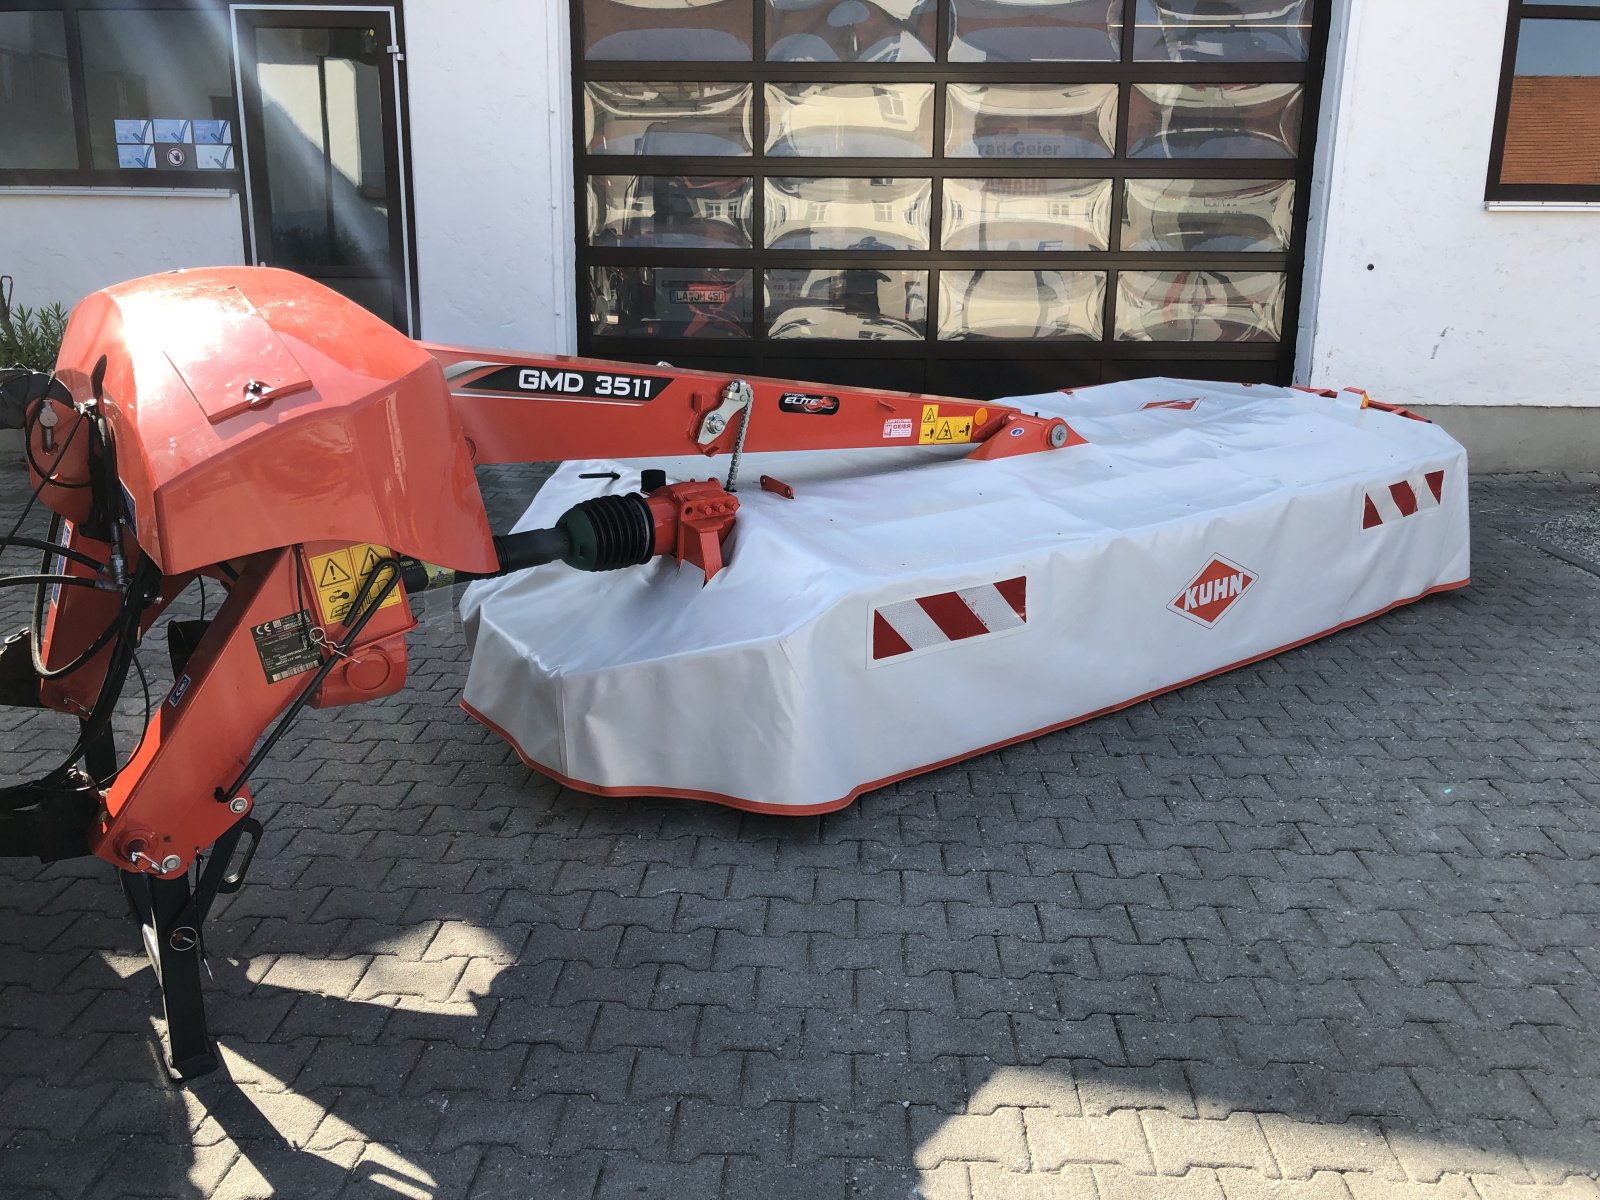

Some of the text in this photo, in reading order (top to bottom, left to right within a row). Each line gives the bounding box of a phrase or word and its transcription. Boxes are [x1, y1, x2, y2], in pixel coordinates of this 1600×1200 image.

[518, 369, 651, 398] GMD 3511
[784, 396, 819, 406] ELITE
[1184, 572, 1244, 611] KUHN
